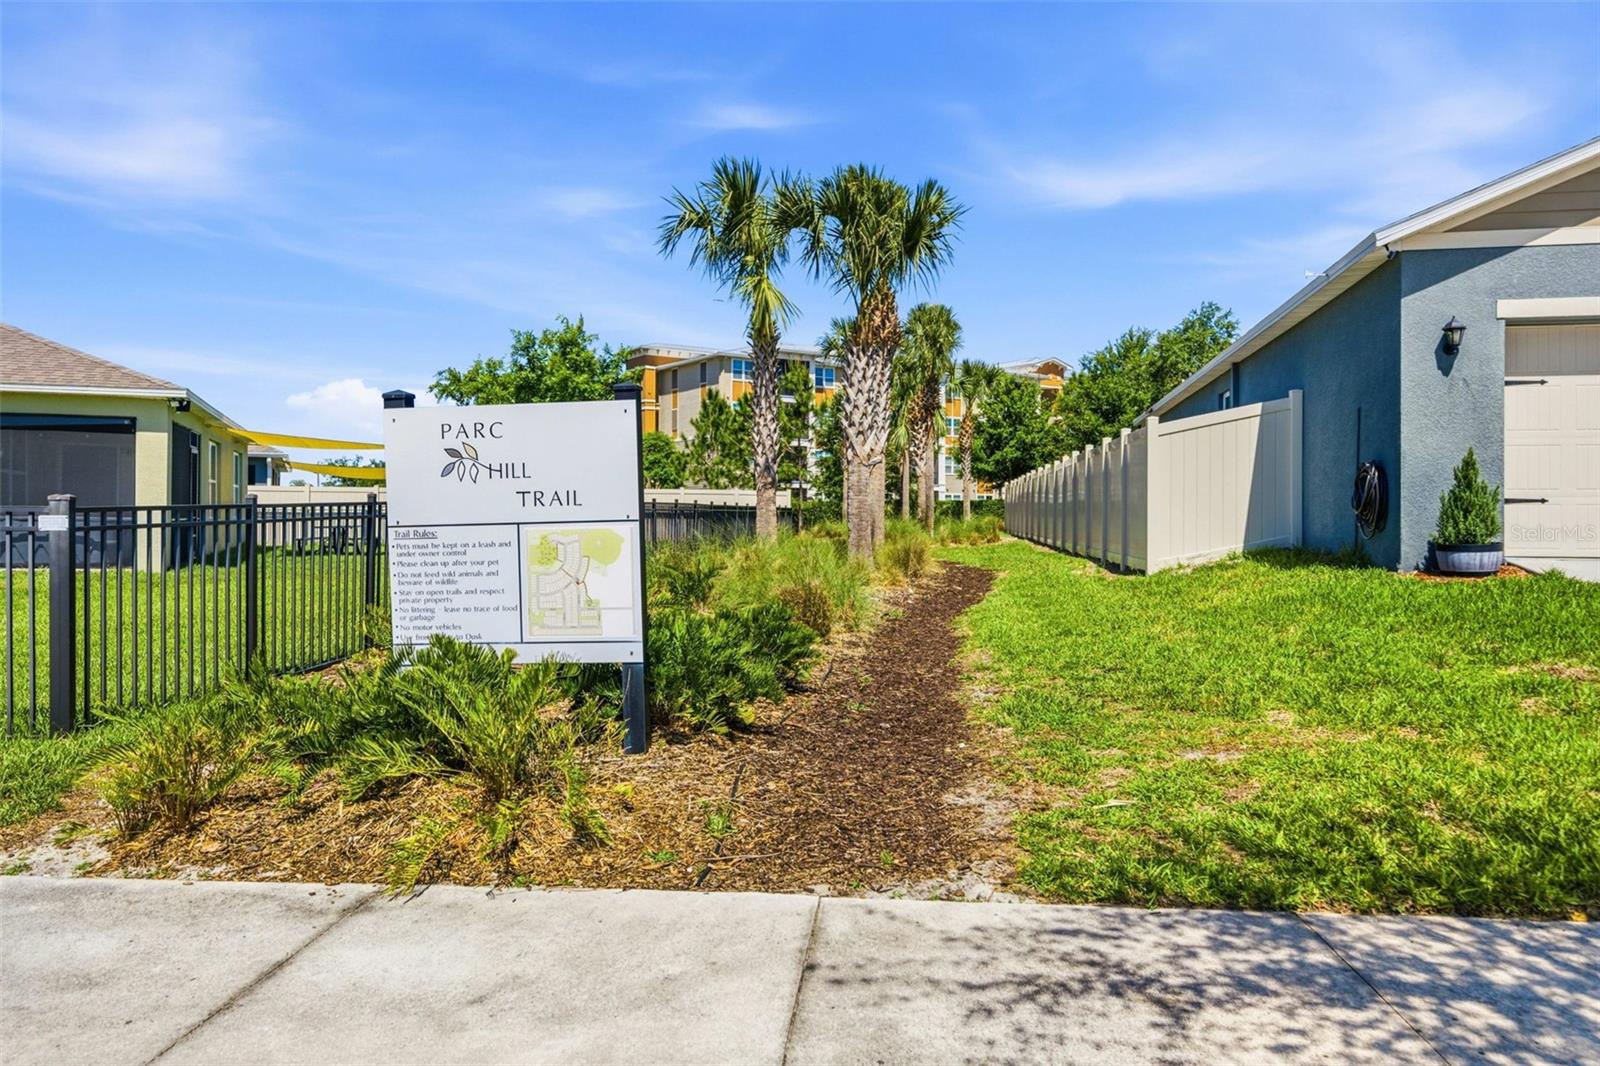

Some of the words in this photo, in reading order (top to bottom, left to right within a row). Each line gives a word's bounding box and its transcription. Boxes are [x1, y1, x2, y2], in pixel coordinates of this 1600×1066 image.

[441, 421, 503, 439] PARC
[489, 462, 531, 479] HILL
[516, 490, 582, 507] TRAIL
[413, 530, 437, 538] Rules:
[443, 542, 458, 550] kept
[409, 614, 435, 622] garbage
